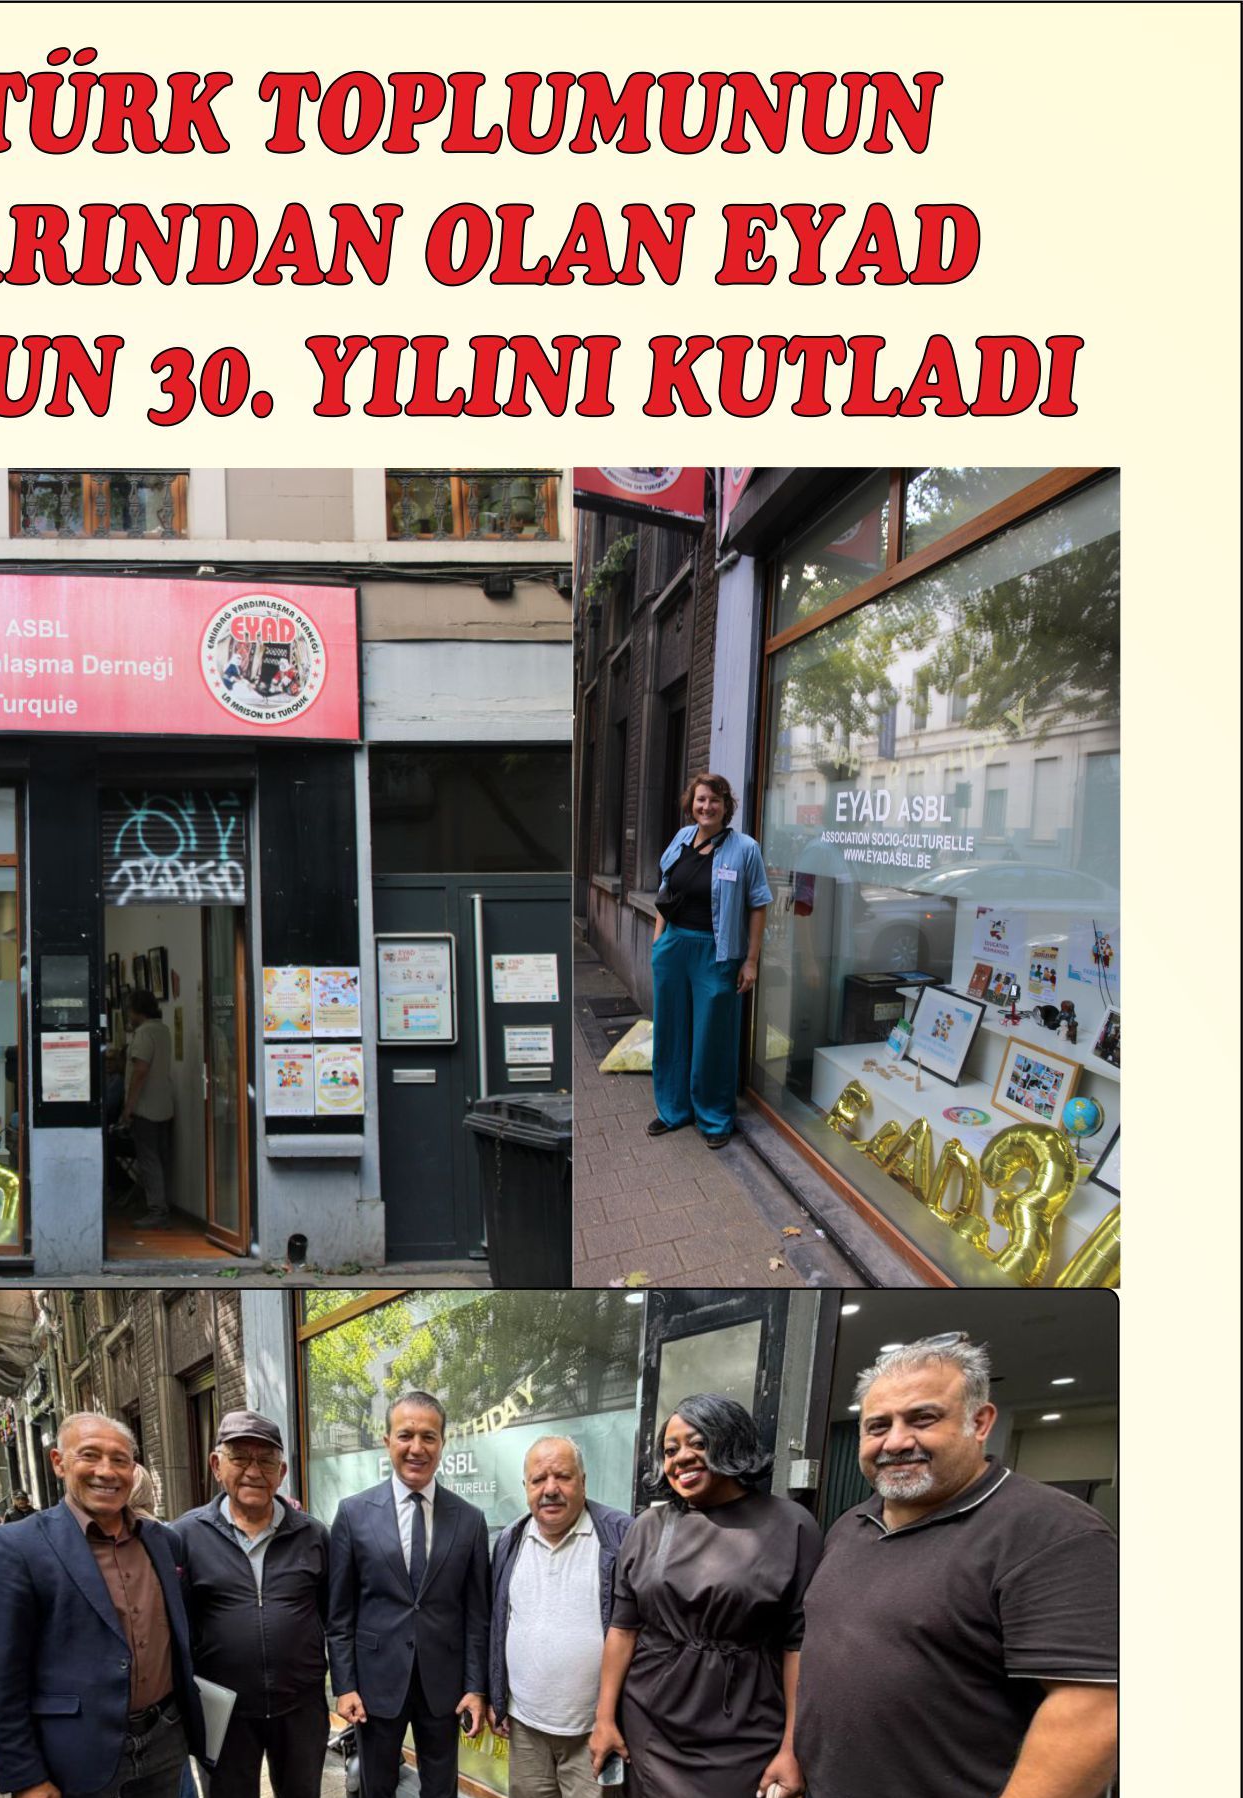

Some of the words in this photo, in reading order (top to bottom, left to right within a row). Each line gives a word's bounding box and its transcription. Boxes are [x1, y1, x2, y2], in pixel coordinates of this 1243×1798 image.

[5, 619, 69, 638] ASBL
[231, 616, 296, 643] EYAD
[82, 655, 174, 681] Derneği
[221, 692, 231, 703] LA
[230, 701, 263, 719] MAISON
[265, 710, 277, 719] DE
[277, 695, 309, 718] TURQUIE
[835, 789, 891, 822] EYAD
[897, 795, 952, 823] ASBL
[821, 831, 870, 846] ASSOCIATION
[871, 832, 975, 852] SOCIO-CULTURELLE
[844, 848, 932, 869] WWW.EYADASBL.BE
